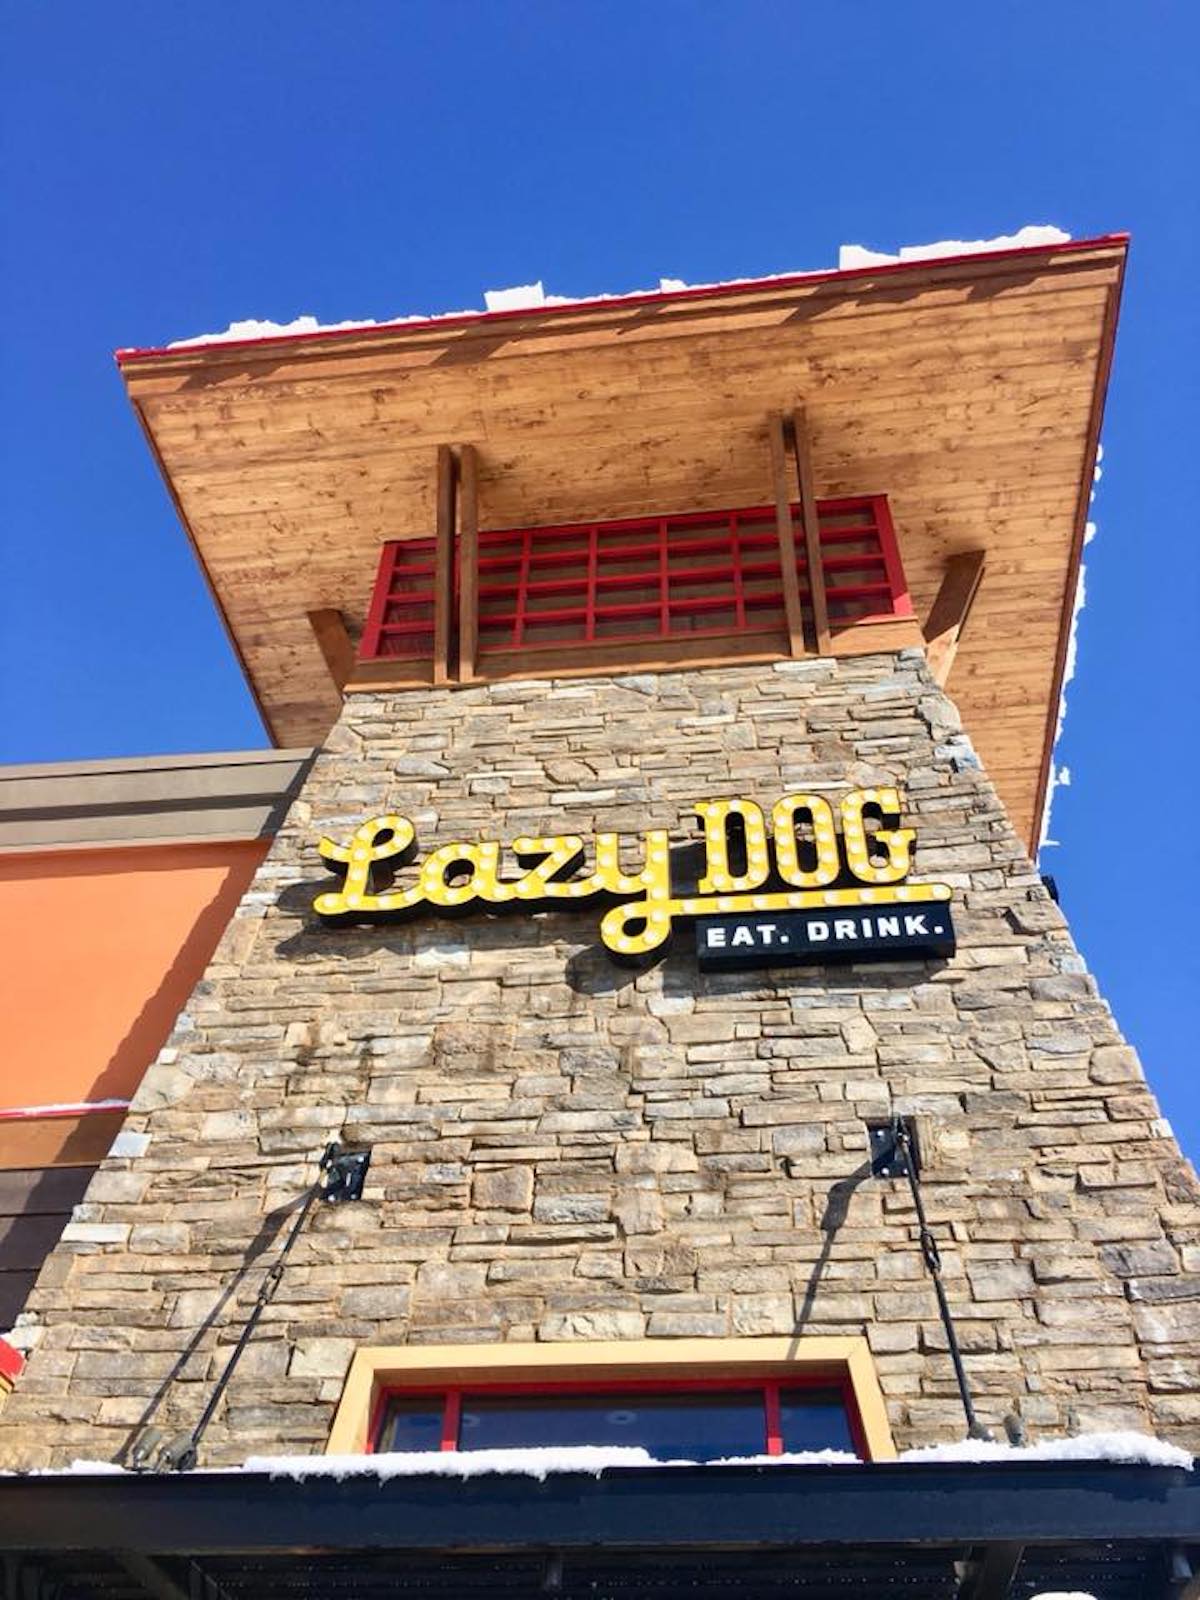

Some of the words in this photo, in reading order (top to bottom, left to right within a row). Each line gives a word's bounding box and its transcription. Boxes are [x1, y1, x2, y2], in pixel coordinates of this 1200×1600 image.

[313, 813, 670, 956] Lazy
[695, 787, 916, 894] DOG
[706, 924, 790, 949] EAT.
[808, 913, 945, 942] DRINK.
